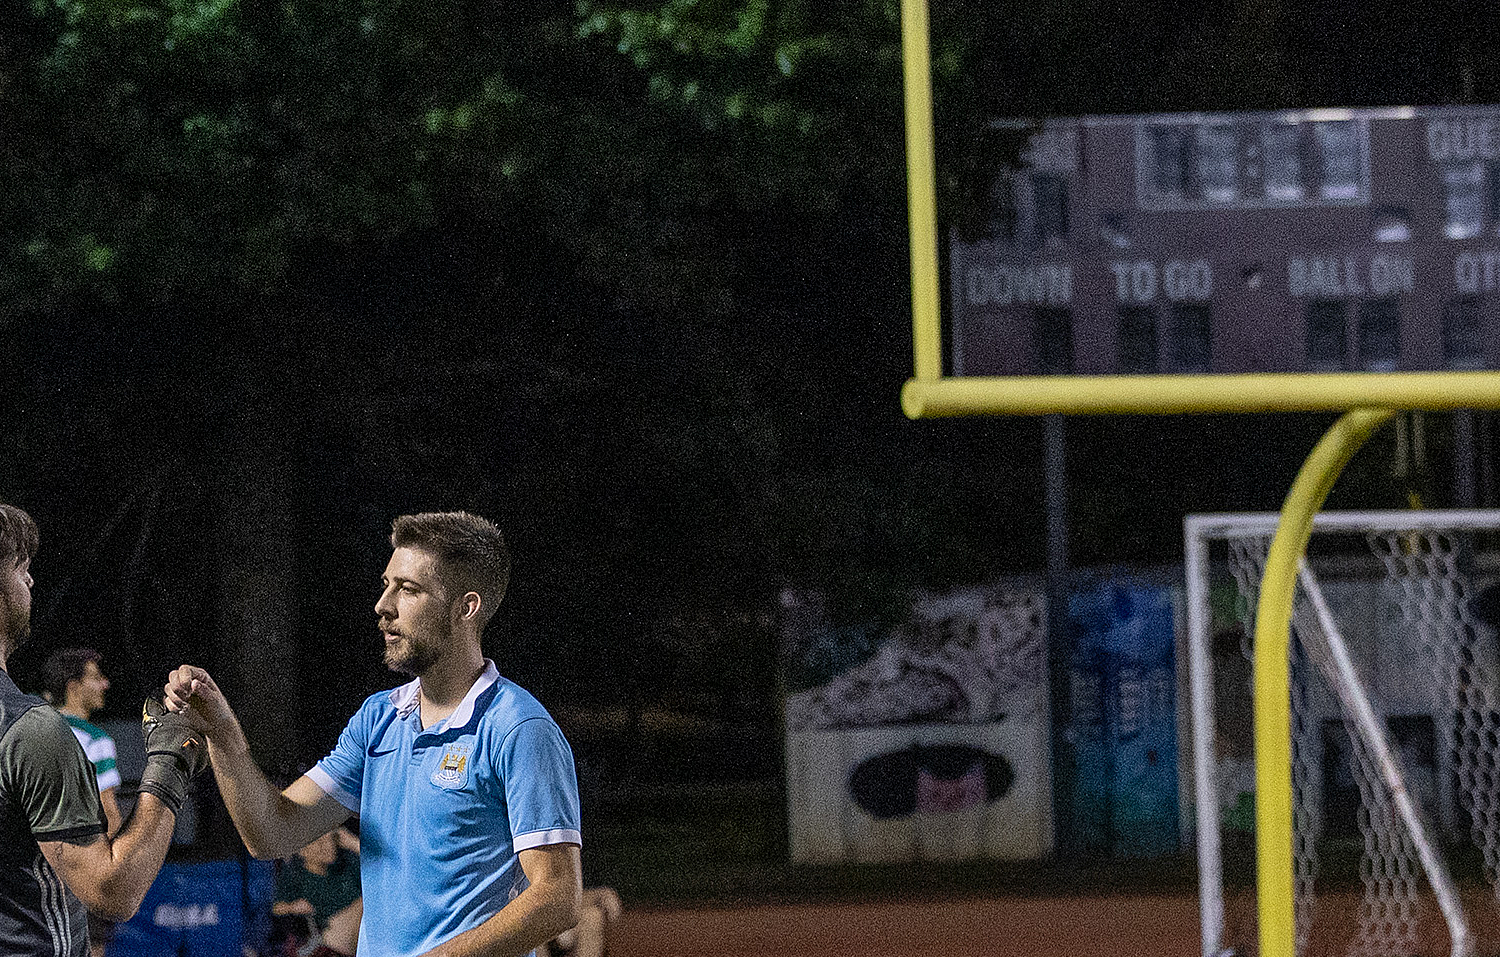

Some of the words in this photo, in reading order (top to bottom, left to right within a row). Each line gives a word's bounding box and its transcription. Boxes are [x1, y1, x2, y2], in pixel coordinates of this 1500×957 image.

[966, 264, 1072, 304] DOWN
[1111, 258, 1157, 301] TO
[1164, 257, 1212, 300] GO
[1289, 255, 1365, 296] BALL
[1371, 253, 1414, 295] ON
